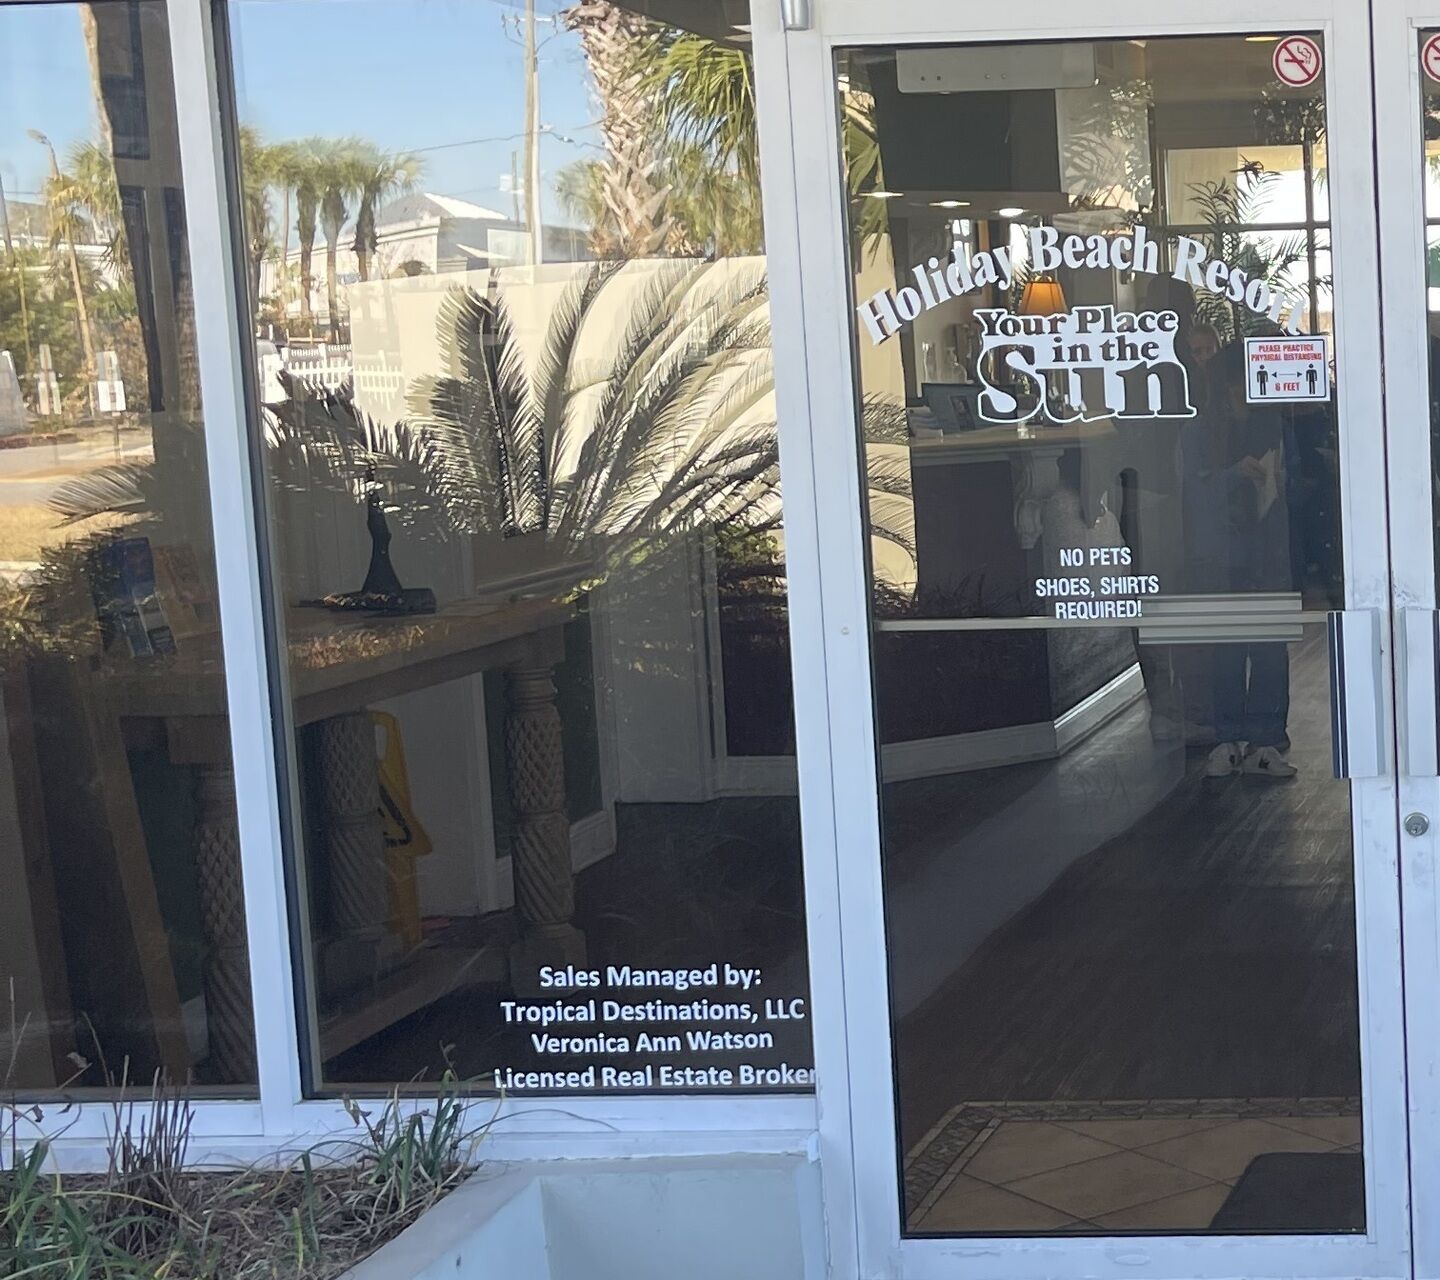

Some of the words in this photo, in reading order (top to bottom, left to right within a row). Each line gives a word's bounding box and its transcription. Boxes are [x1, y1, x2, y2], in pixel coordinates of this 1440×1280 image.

[856, 243, 1013, 347] Holiday
[1029, 224, 1159, 275] Beach
[1171, 235, 1306, 336] Resort
[977, 310, 1067, 337] Your
[1073, 308, 1178, 335] Place
[1052, 336, 1093, 363] in
[1101, 335, 1160, 363] the
[1251, 353, 1281, 361] PHYSICAL
[1258, 344, 1281, 352] PLEASE
[1283, 344, 1314, 352] PRACTICE
[978, 343, 1197, 424] Sun
[1283, 382, 1300, 391] FEET
[1060, 548, 1083, 566] NO
[1090, 546, 1132, 566] PETS
[1035, 577, 1095, 598] SHOES,
[1100, 575, 1160, 595] SHIRTS
[1055, 599, 1142, 619] REQUIRED!
[539, 965, 601, 988] Sales
[607, 964, 717, 991] Managed
[724, 963, 762, 989] by:
[500, 1000, 596, 1026] Tropical
[603, 999, 759, 1024] Destinations,
[765, 999, 805, 1020] LLC
[531, 1031, 630, 1054] Veronica
[636, 1032, 681, 1052] Ann
[686, 1030, 773, 1051] Watson
[494, 1066, 595, 1089] Licensed
[602, 1065, 652, 1087] Real
[660, 1064, 732, 1086] Estate
